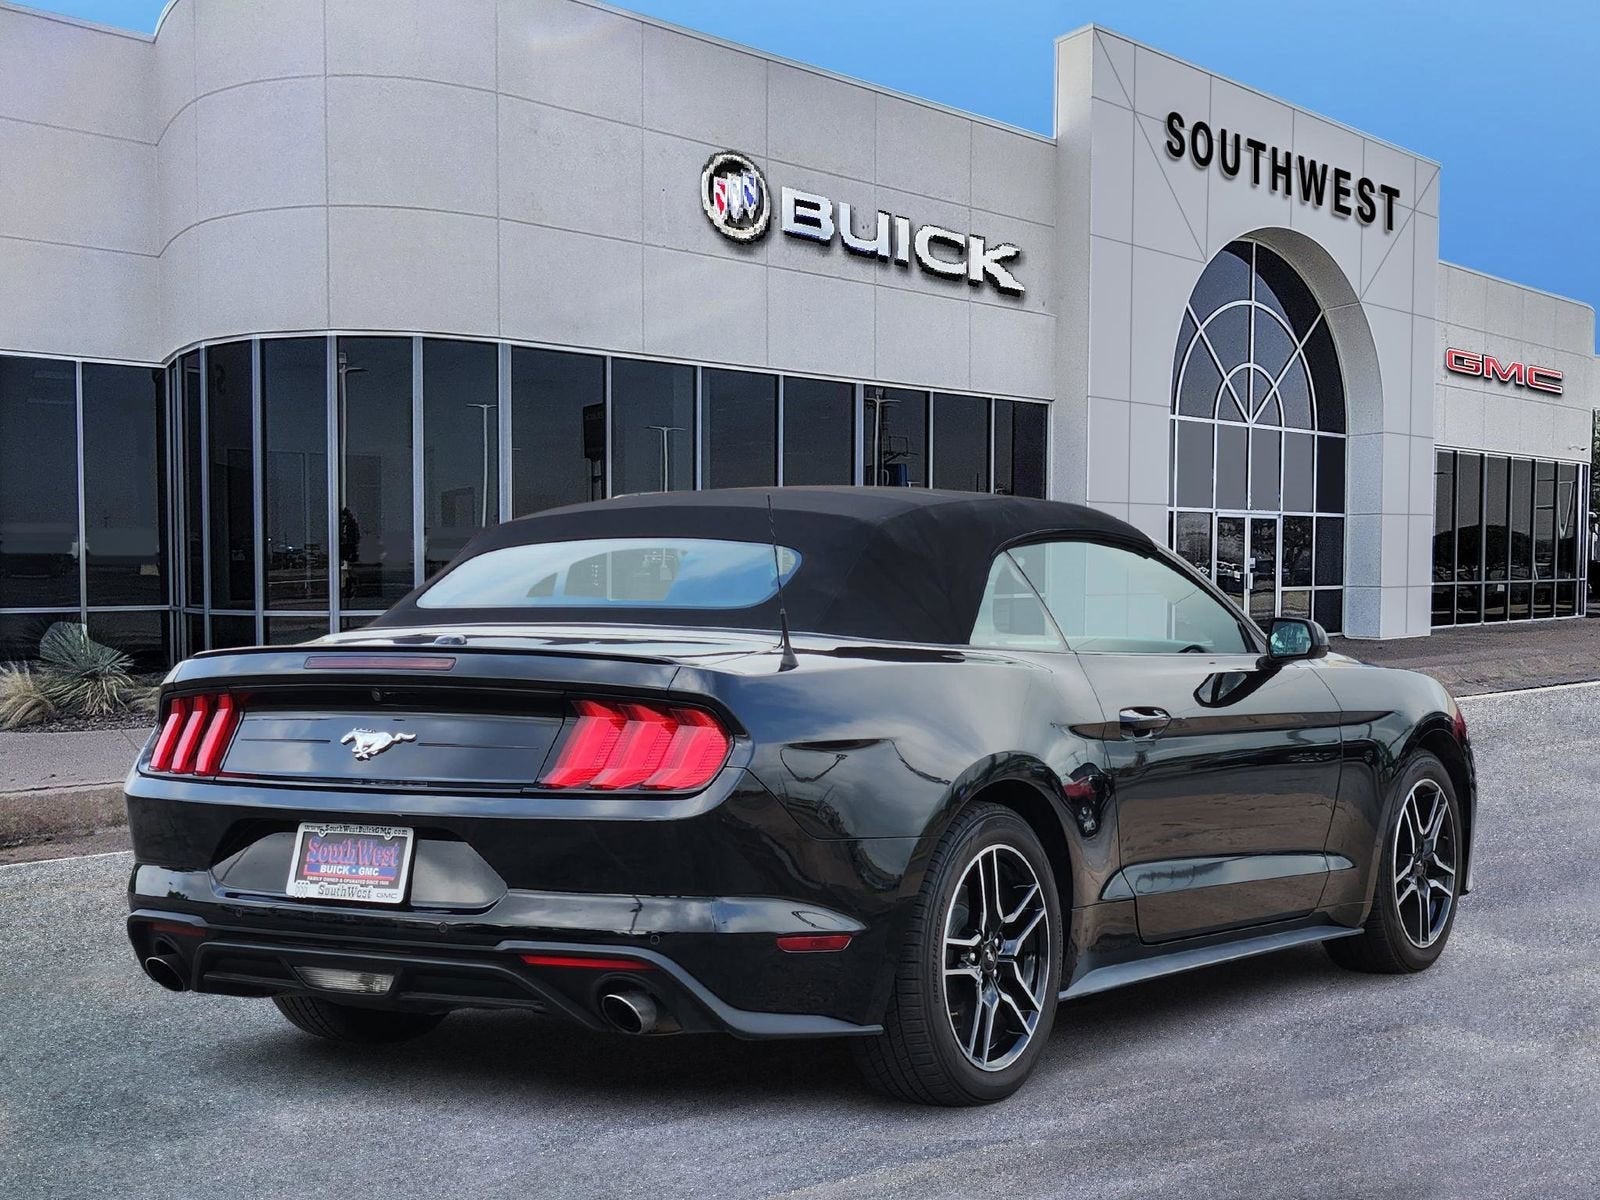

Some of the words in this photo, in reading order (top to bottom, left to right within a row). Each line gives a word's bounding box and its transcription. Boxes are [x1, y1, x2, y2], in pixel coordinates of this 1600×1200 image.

[1166, 112, 1400, 231] SOUTHWEST
[781, 186, 1025, 295] BUICK
[1446, 347, 1563, 394] GMC
[320, 864, 350, 875] BUICK
[358, 868, 380, 876] GMC
